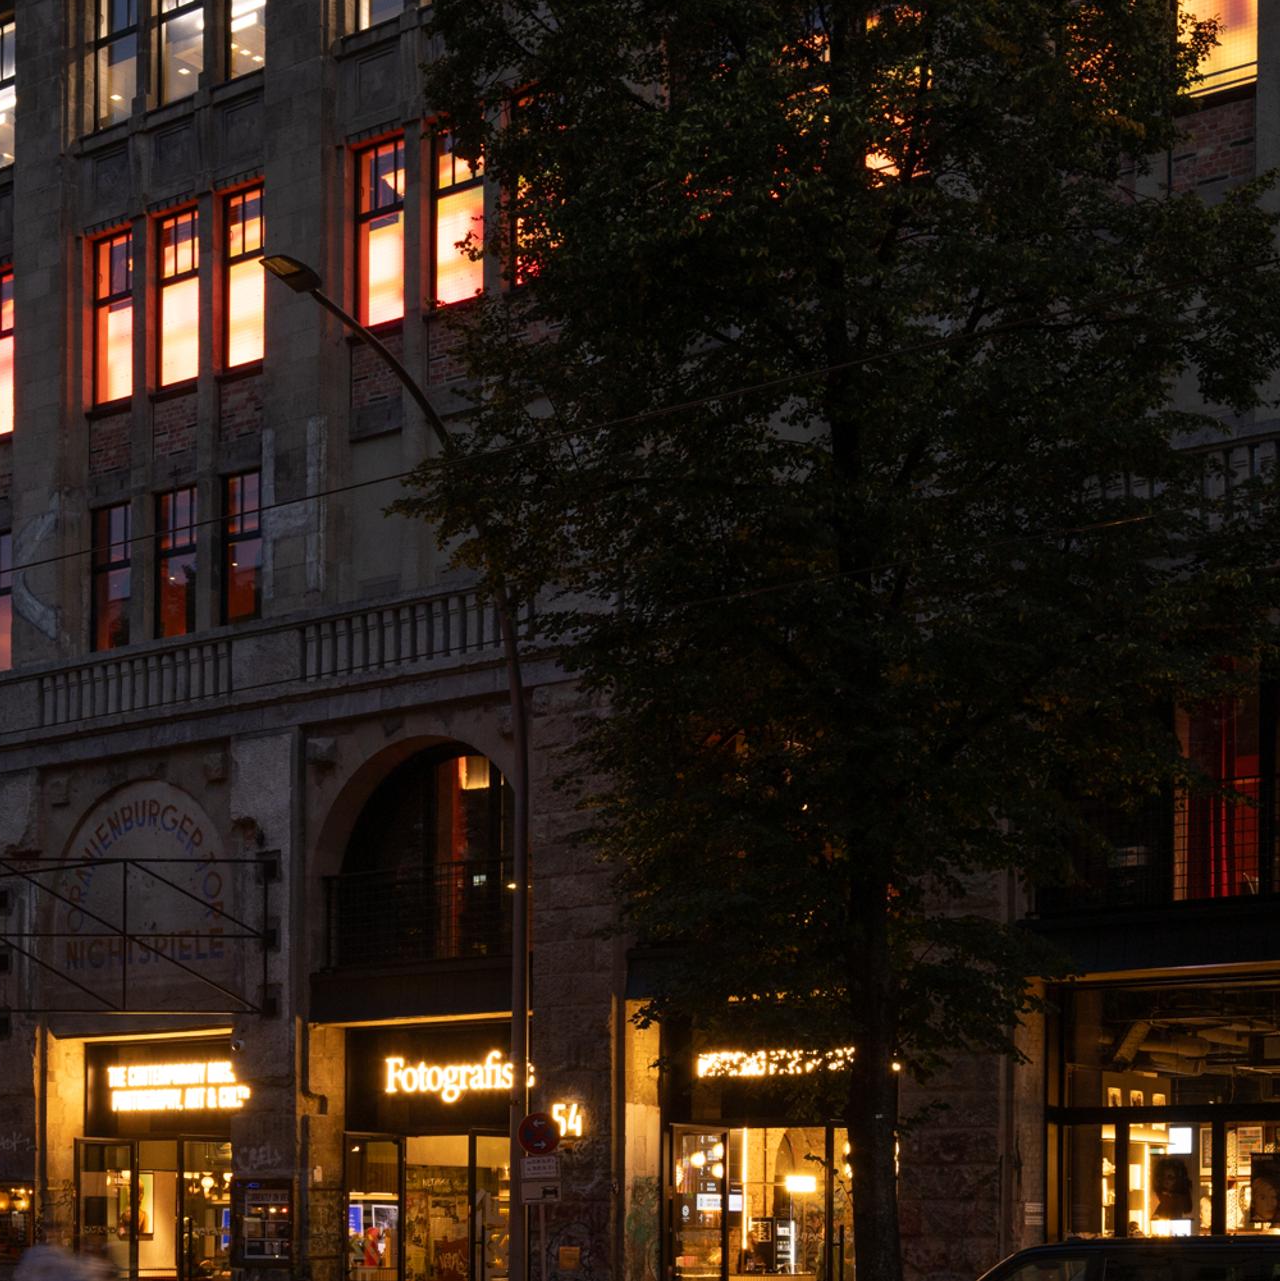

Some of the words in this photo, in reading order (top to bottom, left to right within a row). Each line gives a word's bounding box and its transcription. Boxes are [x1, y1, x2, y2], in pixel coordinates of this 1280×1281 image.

[66, 799, 204, 933] ORANIENBURGER
[195, 850, 225, 919] TOR
[552, 1103, 583, 1137] 54
